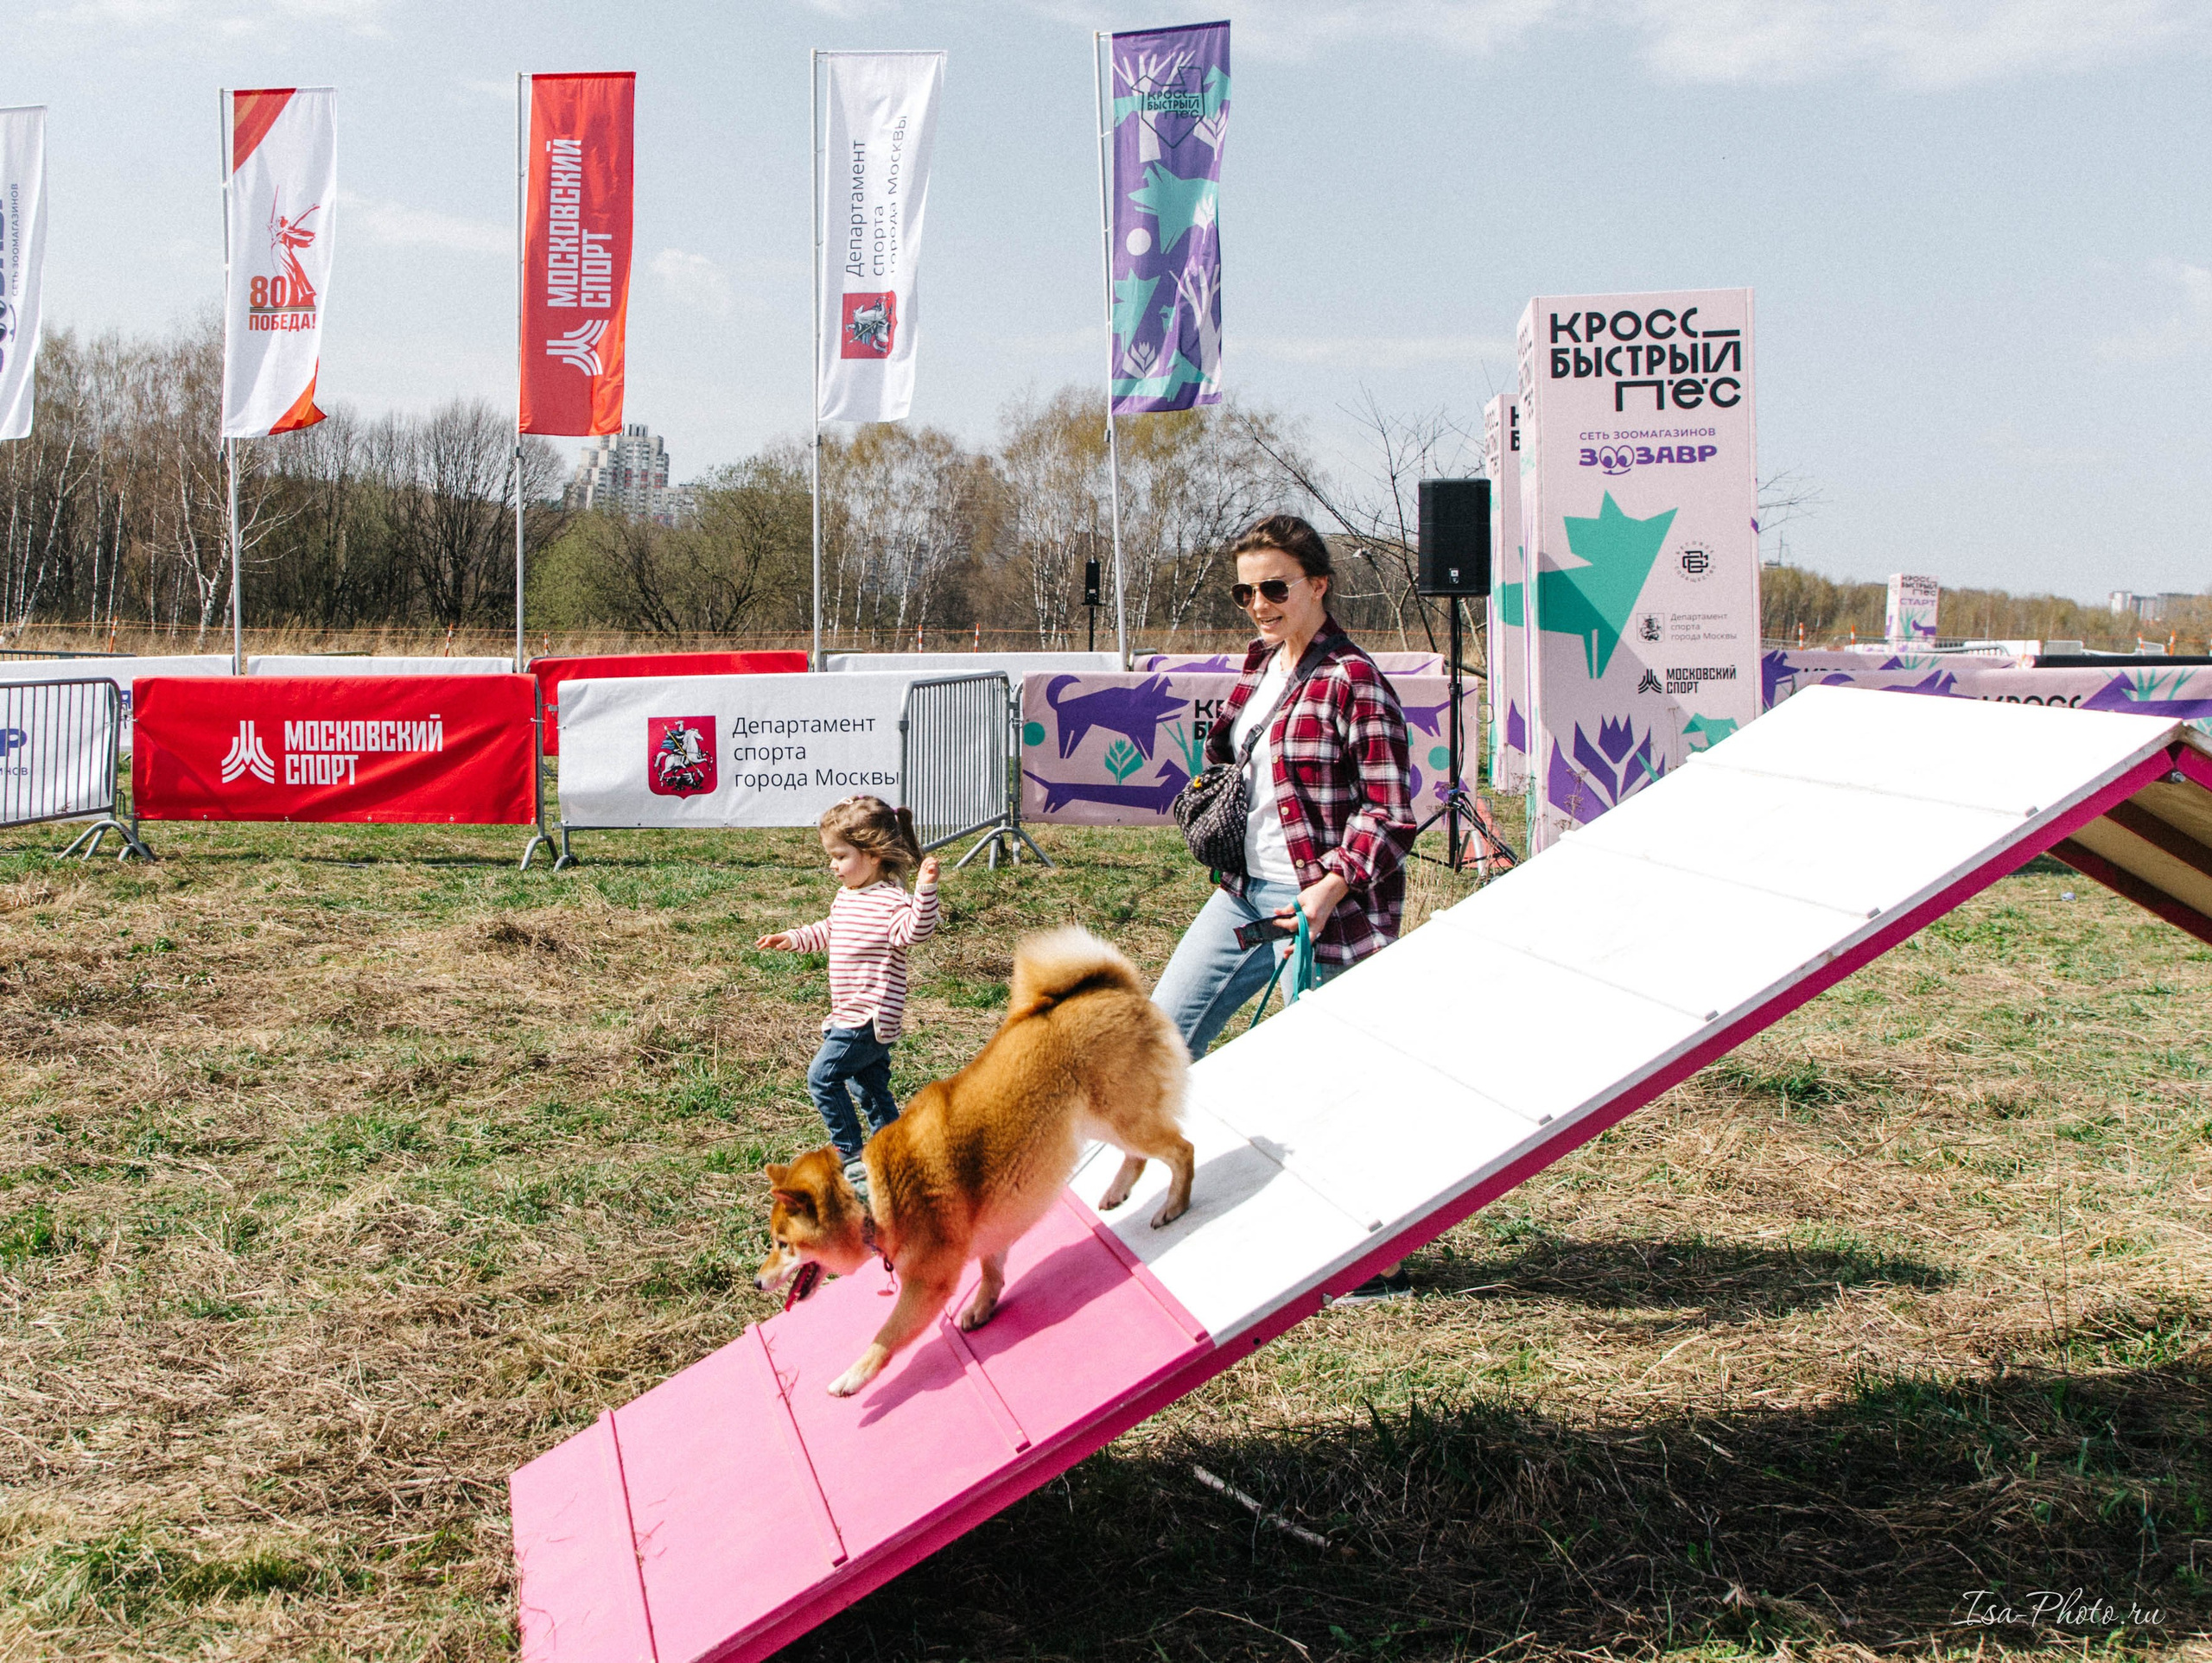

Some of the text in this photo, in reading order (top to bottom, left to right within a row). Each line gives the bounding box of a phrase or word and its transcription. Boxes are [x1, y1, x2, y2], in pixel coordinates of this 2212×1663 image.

[1147, 90, 1188, 100] КРОСС
[1147, 96, 1199, 111] БЫСТРЫЙ
[887, 116, 907, 195] Москвы
[846, 140, 868, 277] Департамент
[546, 139, 582, 307] МОСКОВСКИЙ
[873, 206, 887, 276] спорта
[581, 229, 613, 308] СПОРТ
[250, 276, 287, 308] 80
[249, 313, 316, 332] ПОБЕДА!
[1550, 307, 1699, 344] КРОСС
[1550, 329, 1741, 379] БЫСТРЫЙ
[1580, 428, 1716, 441] СЕТЬ ЗООМАГАЗИНОВ
[1900, 598, 1936, 606] СТАРТ
[1670, 613, 1728, 622] Департамент
[1666, 664, 1737, 681] МОСКОВСКИЙ
[1667, 681, 1699, 694] СПОРТ
[284, 714, 443, 752] МОСКОВСКИЙ
[732, 717, 876, 739] Департамент
[734, 746, 806, 765] спорта
[285, 753, 359, 785] СПОРТ
[735, 768, 899, 792] города Москвы
